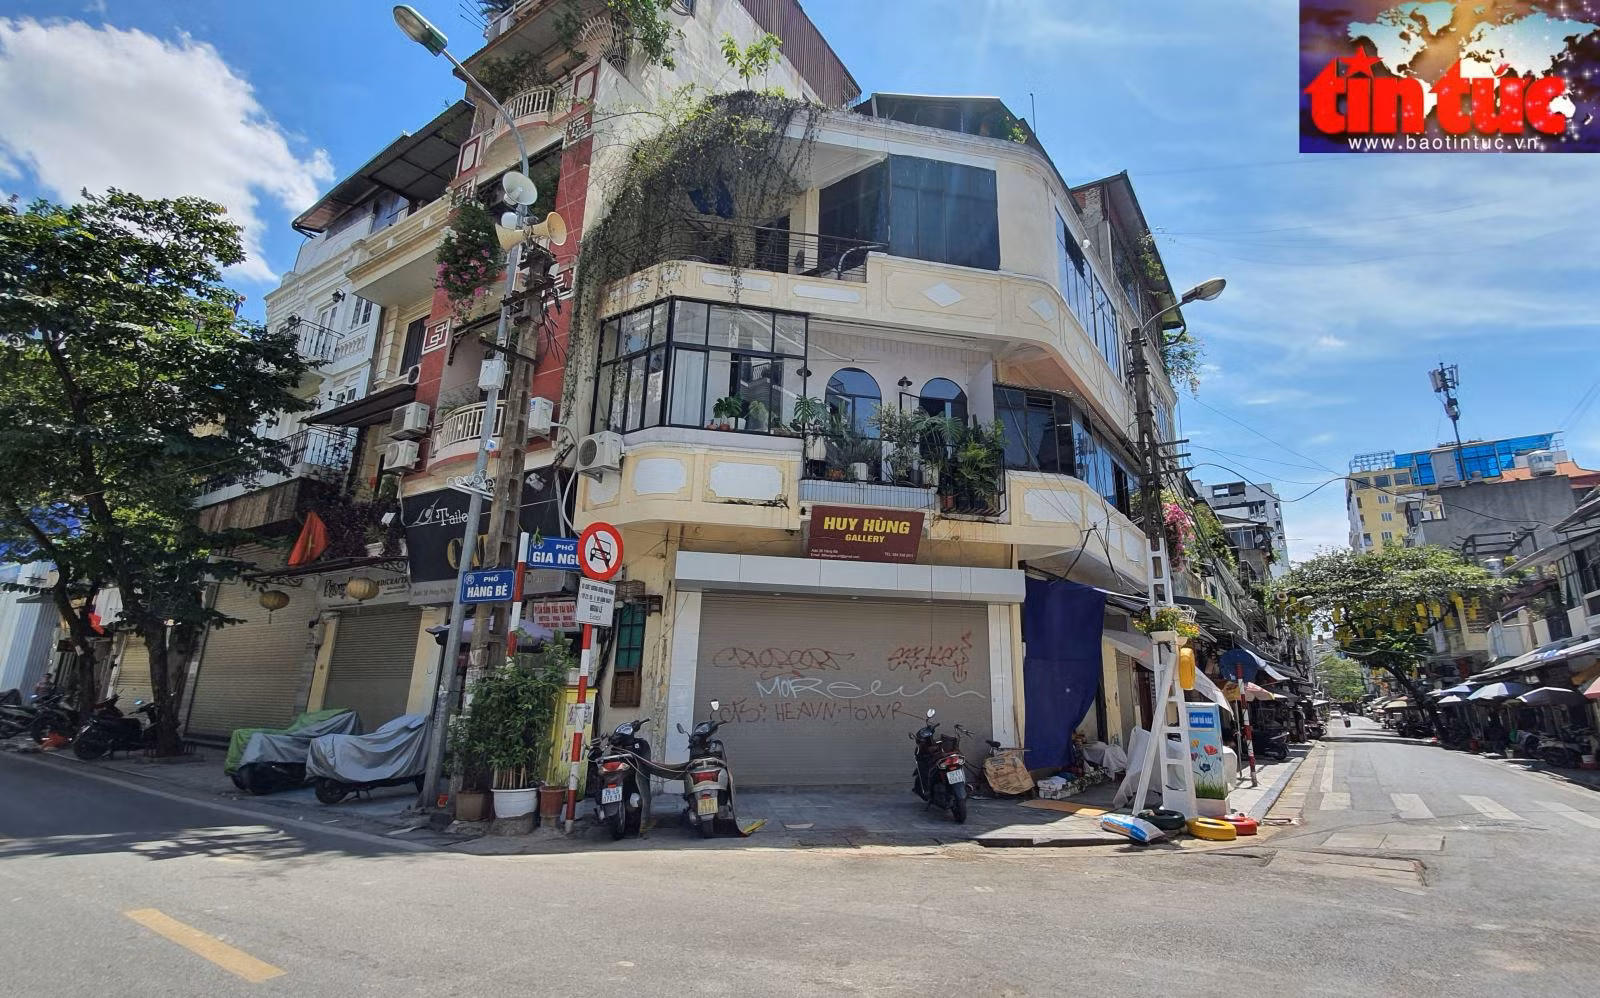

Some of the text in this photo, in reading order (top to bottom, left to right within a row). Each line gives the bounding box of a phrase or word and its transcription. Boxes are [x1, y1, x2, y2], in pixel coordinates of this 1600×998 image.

[436, 507, 469, 527] Tailo
[823, 516, 911, 534] HUY HÙNG
[845, 533, 885, 543] GALLERY
[555, 543, 576, 551] PHỐ
[532, 551, 554, 564] GIA
[483, 574, 500, 583] PHỐ
[467, 584, 493, 598] HÀNG
